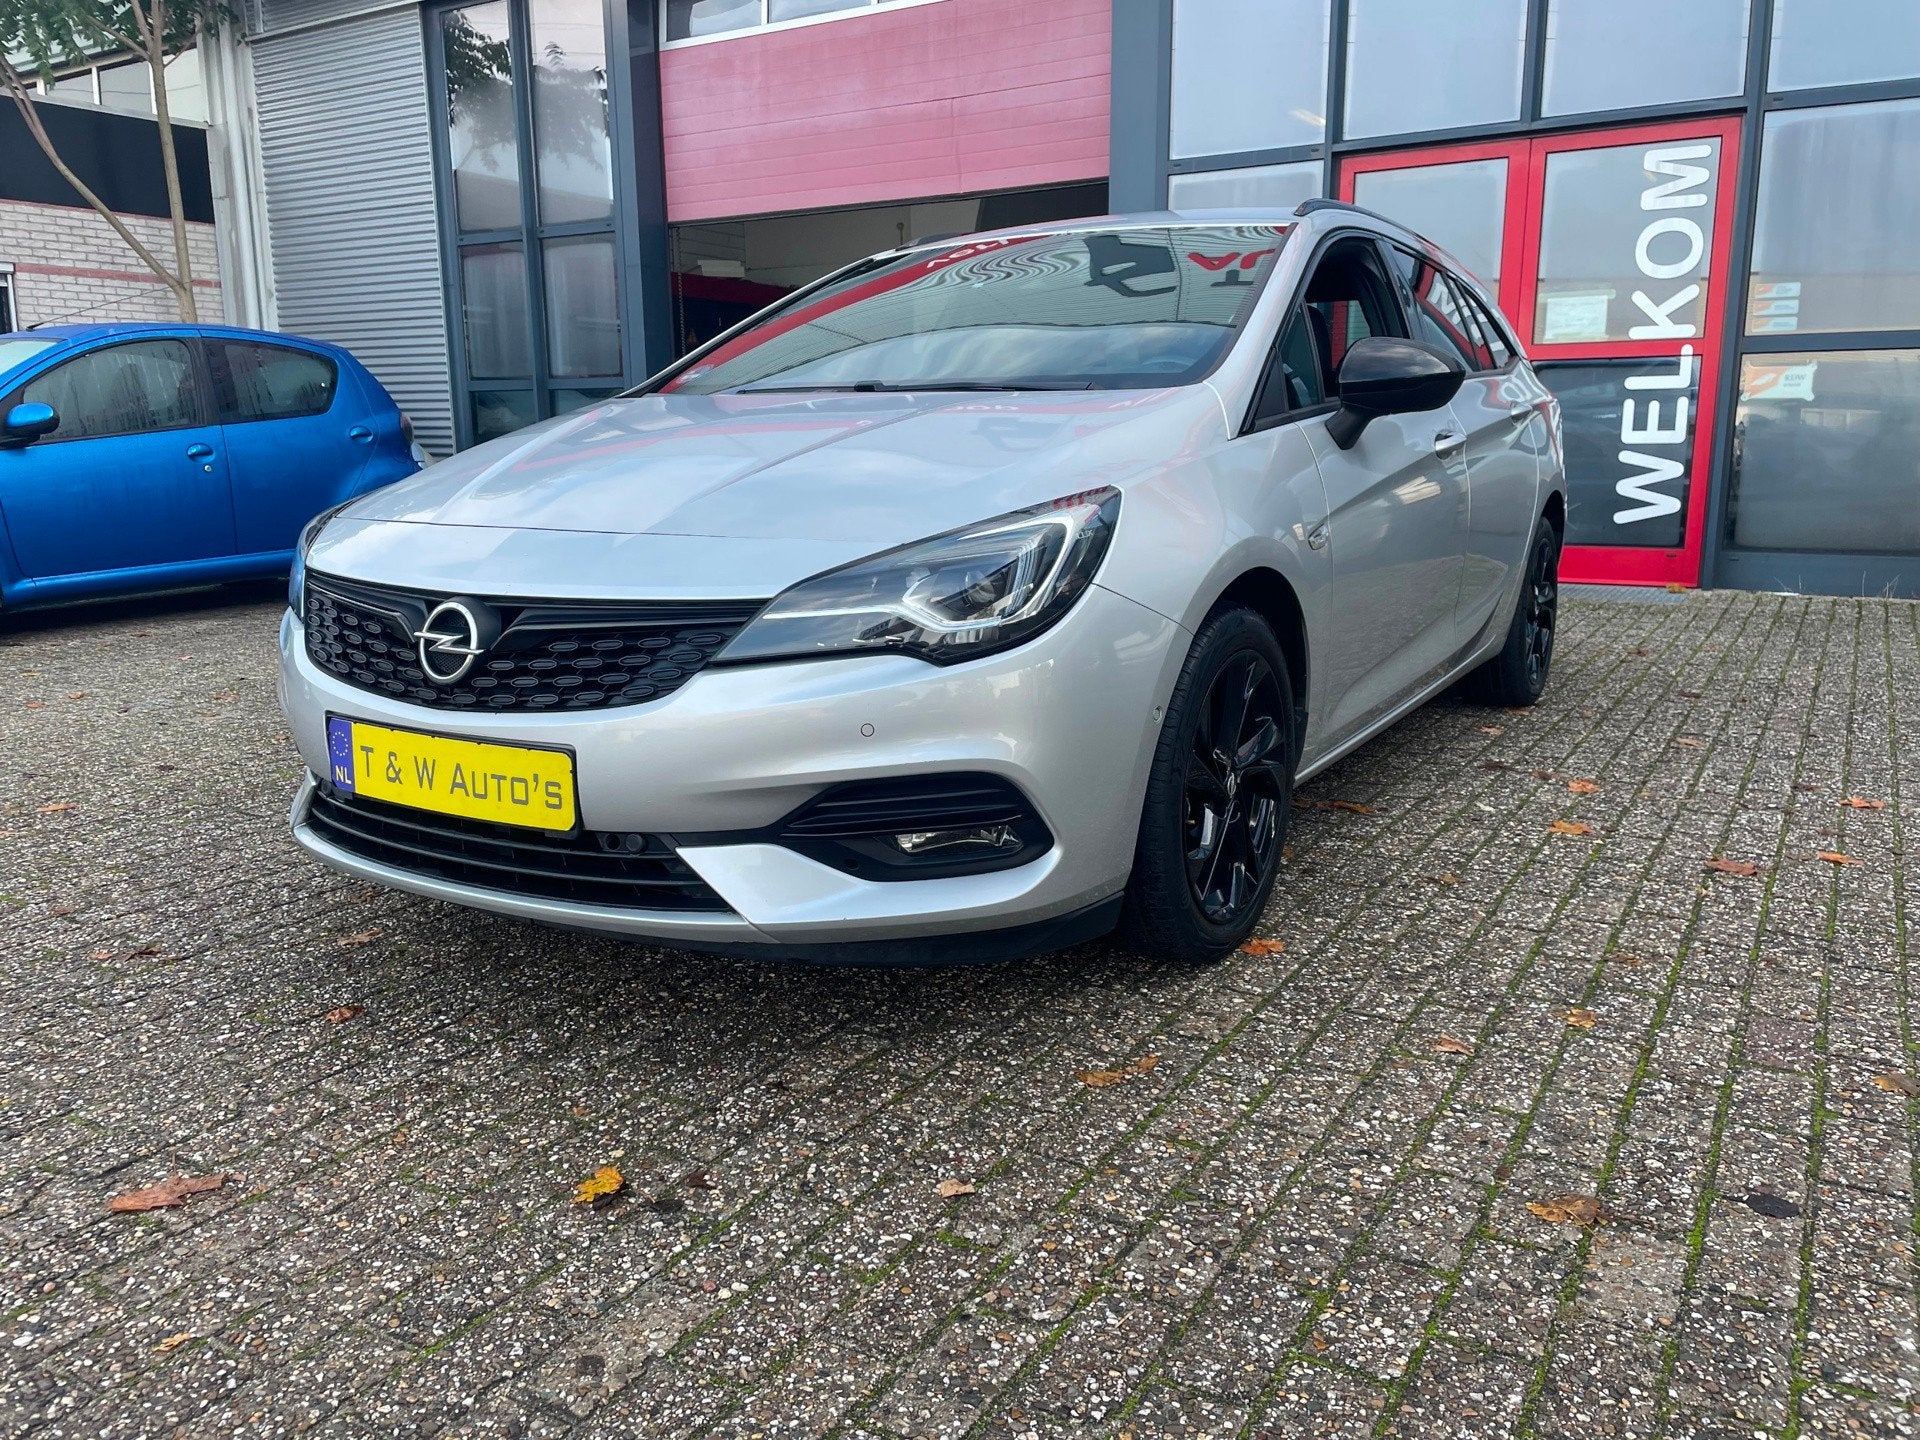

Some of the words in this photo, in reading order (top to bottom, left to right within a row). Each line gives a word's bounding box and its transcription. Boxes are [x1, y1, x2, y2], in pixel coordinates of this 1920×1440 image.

[1613, 144, 1712, 525] WELKOM
[335, 765, 351, 784] NL
[360, 746, 374, 777] T
[385, 751, 403, 785] &
[413, 756, 436, 790] W
